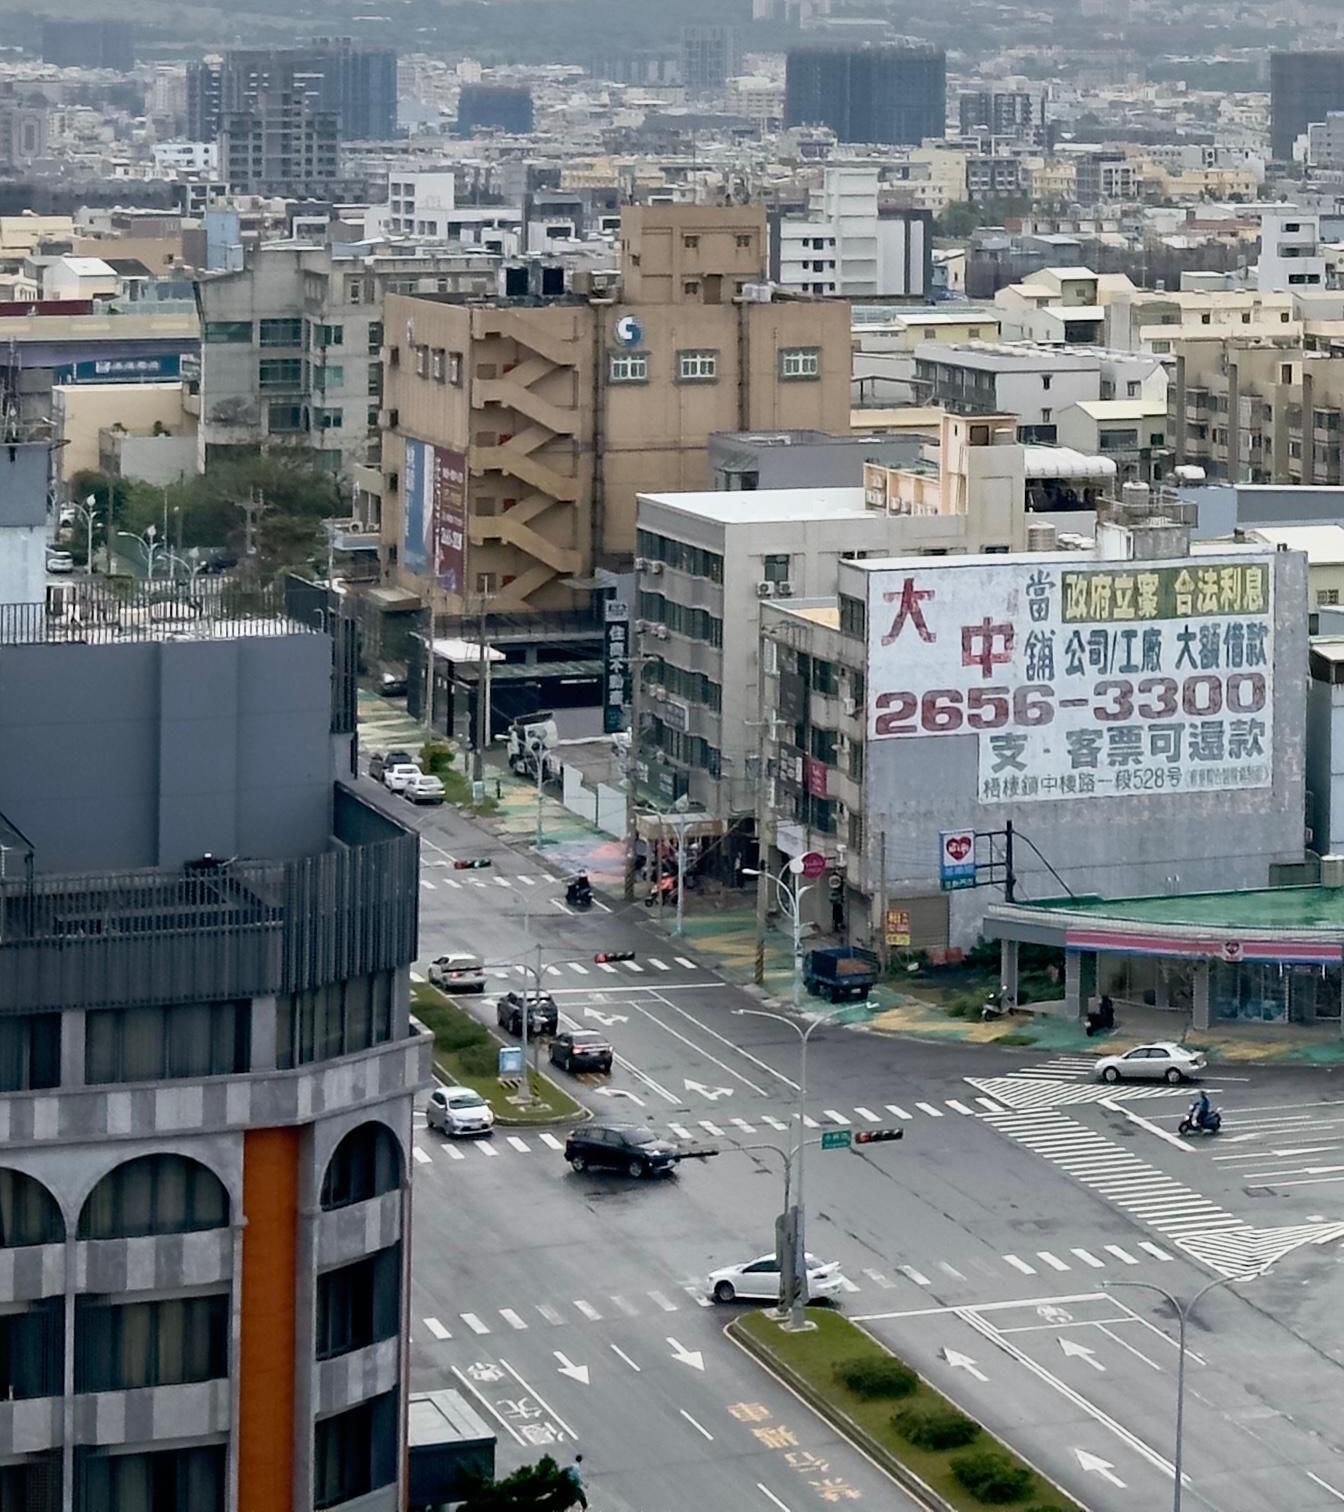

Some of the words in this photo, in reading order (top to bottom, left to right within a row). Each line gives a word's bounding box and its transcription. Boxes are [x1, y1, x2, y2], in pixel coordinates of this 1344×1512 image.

[1065, 571, 1160, 619] 政府立案
[1175, 566, 1265, 616] 合法利息
[1174, 621, 1270, 670] 大額借款
[875, 672, 1266, 735] 2656-3300
